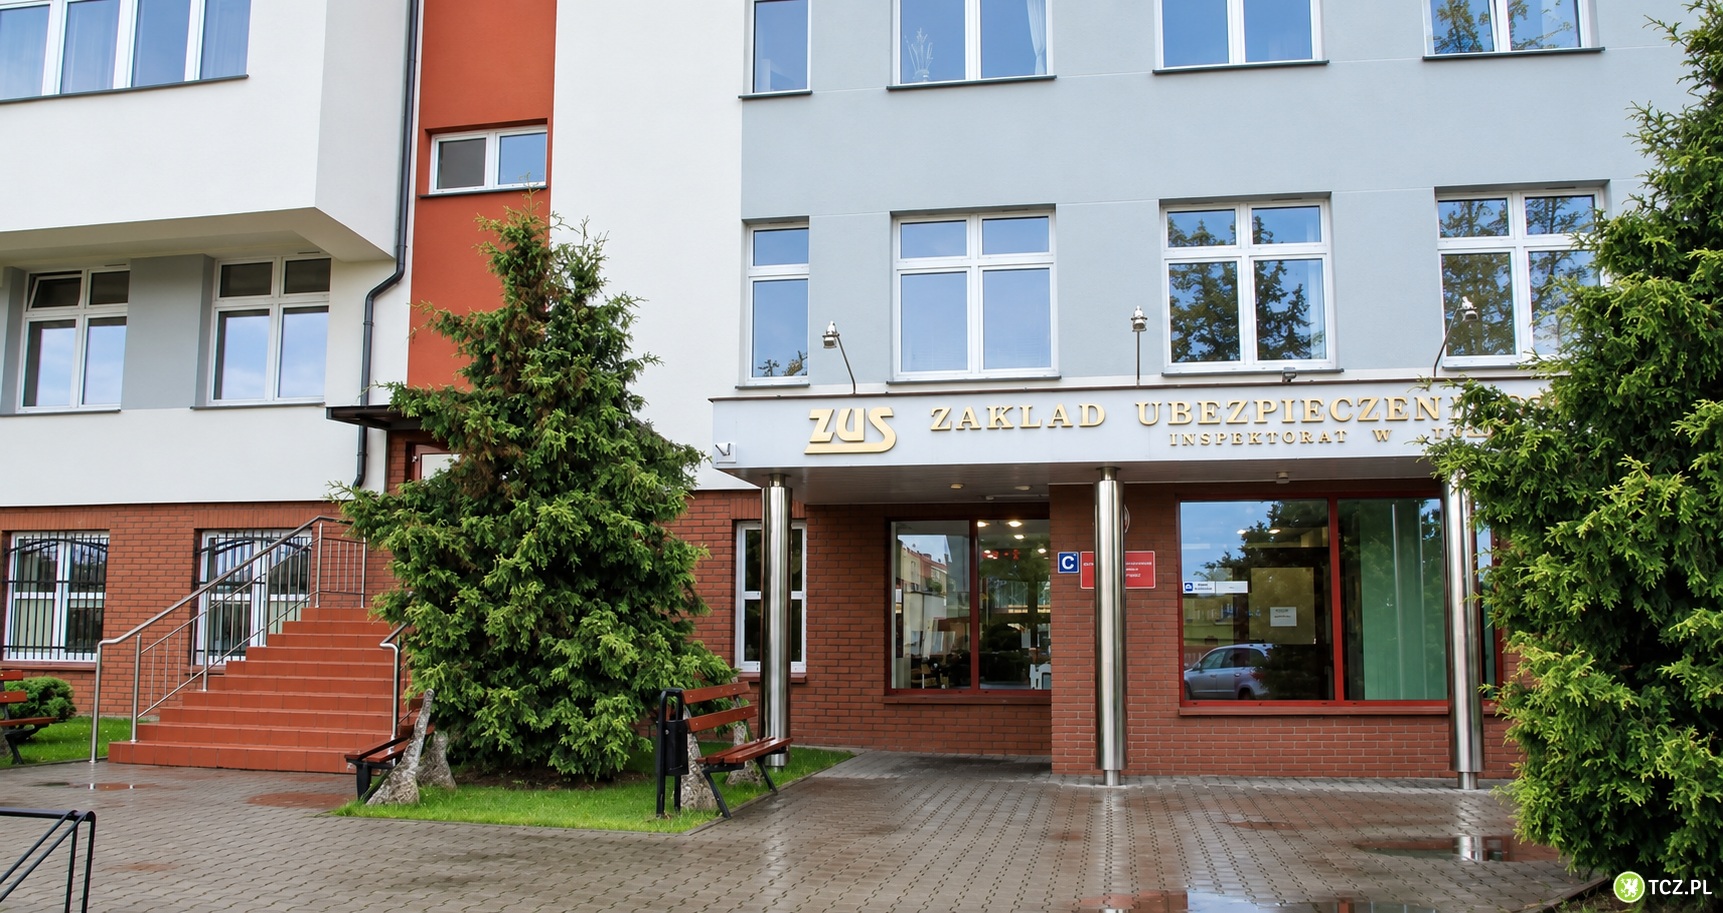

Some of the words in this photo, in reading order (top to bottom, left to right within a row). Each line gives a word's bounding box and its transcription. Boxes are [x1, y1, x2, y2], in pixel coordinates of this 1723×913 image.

[804, 406, 897, 455] ZUS
[1170, 429, 1348, 446] INSPEKTORAT
[1373, 429, 1392, 443] W
[1061, 556, 1075, 570] C
